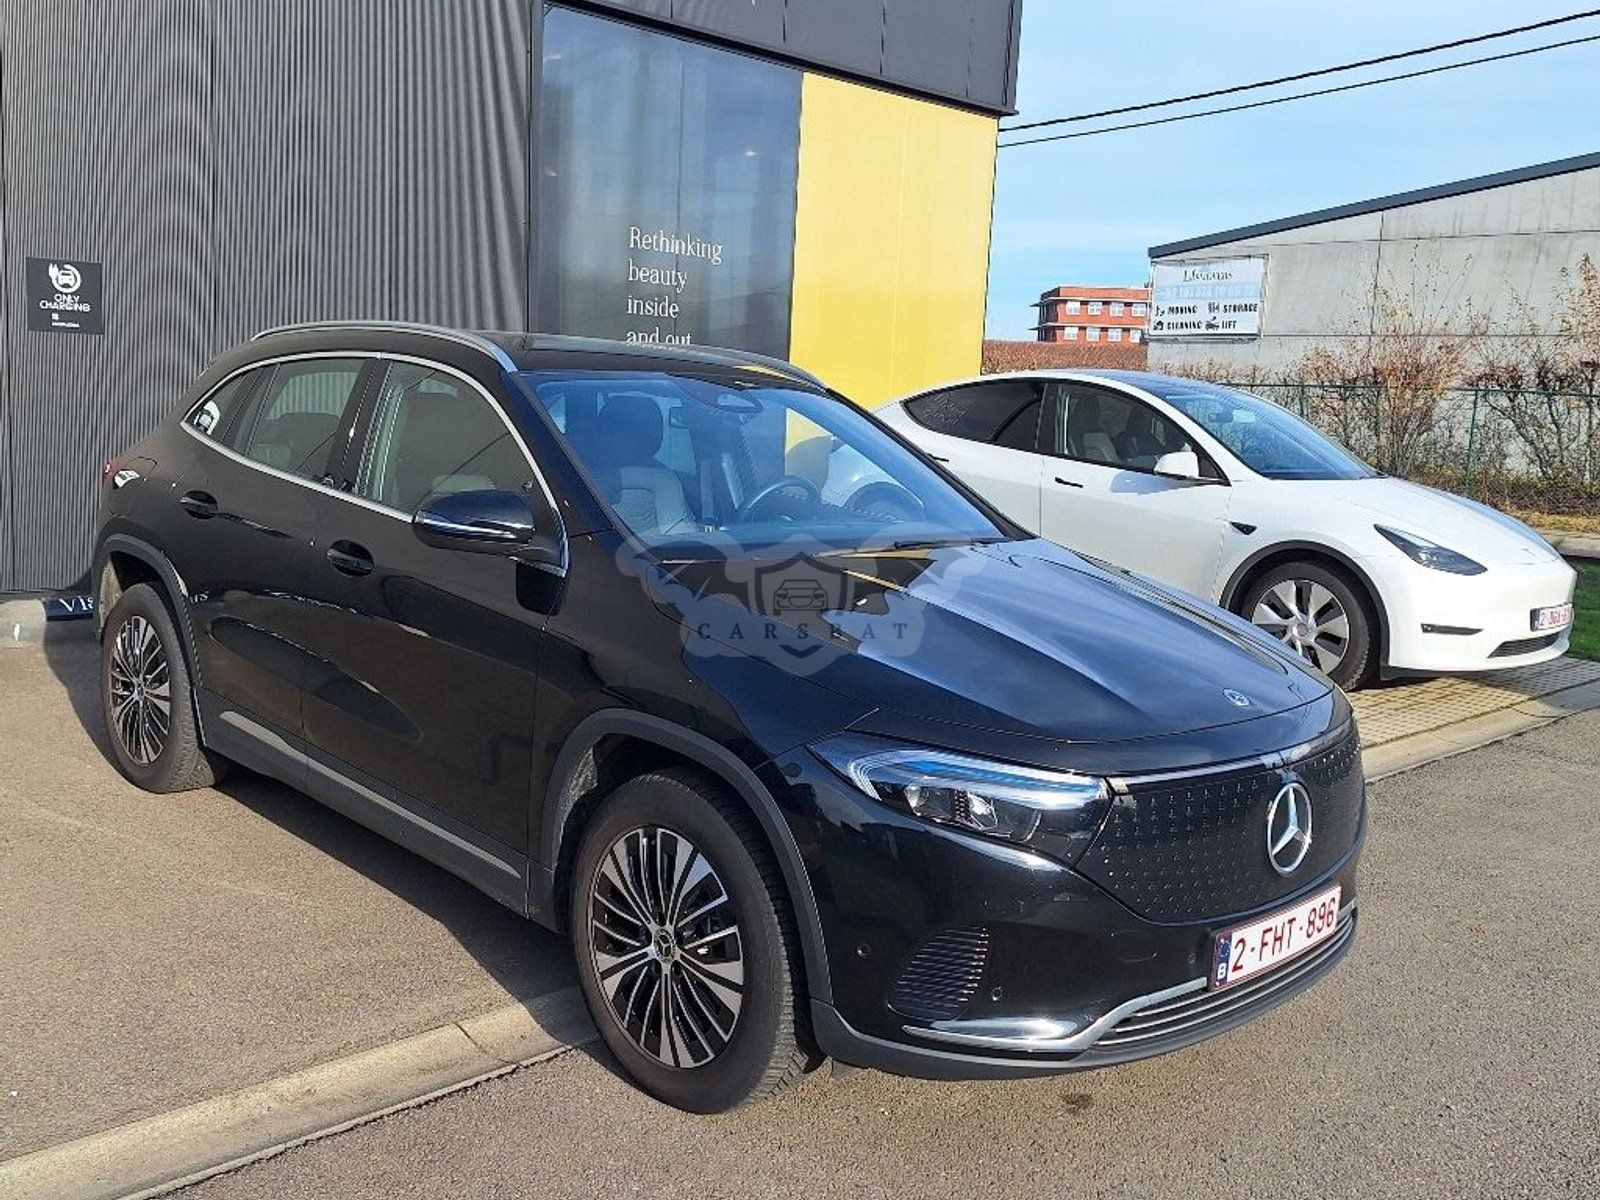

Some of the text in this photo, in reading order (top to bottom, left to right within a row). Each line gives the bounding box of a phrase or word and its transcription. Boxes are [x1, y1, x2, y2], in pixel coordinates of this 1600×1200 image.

[629, 226, 723, 265] Rethinking
[628, 258, 687, 293] beauty
[53, 294, 80, 302] ONLY
[627, 295, 679, 318] inside
[1167, 305, 1198, 315] MOVING
[1223, 303, 1258, 313] STORAGE
[1166, 321, 1202, 330] CLEANING
[1221, 320, 1237, 329] LIFT
[626, 326, 692, 345] and out
[1231, 897, 1336, 973] 2-FHT-896
